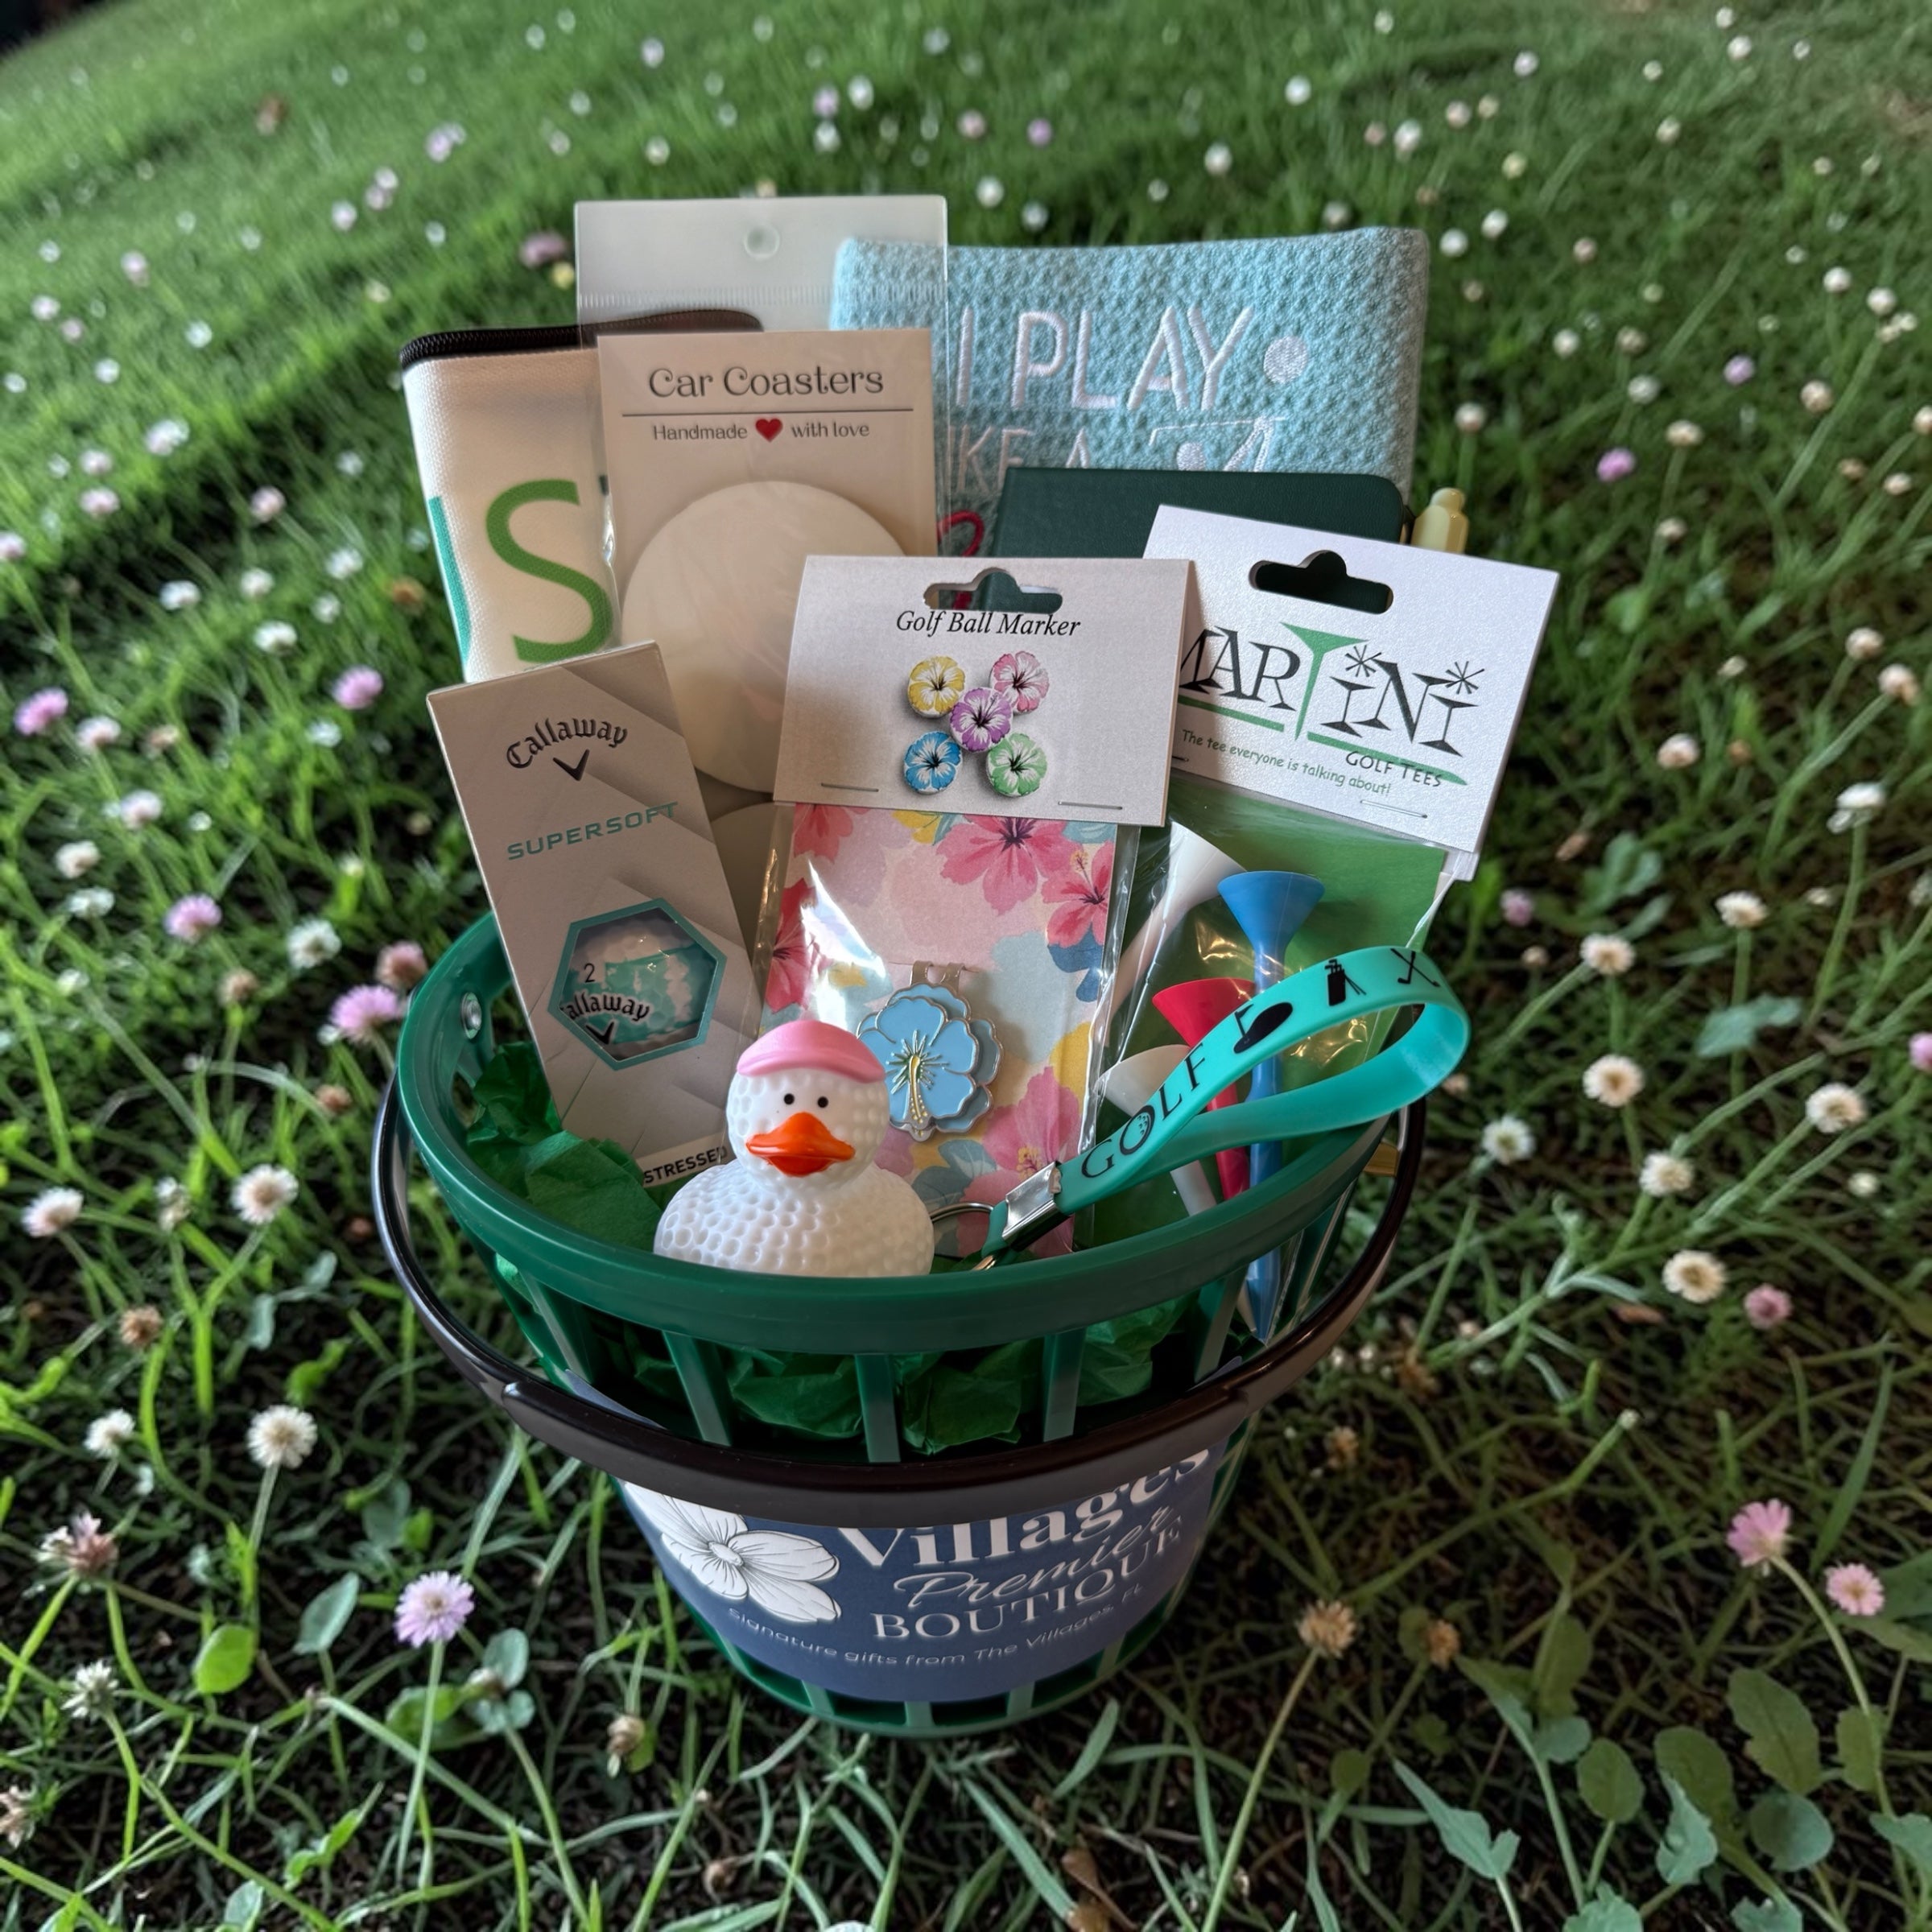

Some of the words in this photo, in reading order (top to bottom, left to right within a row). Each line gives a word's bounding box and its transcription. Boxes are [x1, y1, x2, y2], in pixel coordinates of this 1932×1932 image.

[956, 305, 974, 407] I
[1011, 305, 1256, 411] PLAY
[649, 367, 713, 398] Car
[723, 365, 885, 397] Coasters
[652, 423, 748, 442] Handmade
[791, 421, 828, 440] with
[832, 420, 870, 439] love
[943, 423, 1035, 493] IKE
[896, 609, 945, 638] Golf
[947, 610, 993, 635] Ball
[996, 612, 1082, 637] Marker
[506, 717, 628, 770] Callaway
[1182, 729, 1203, 746] The
[1207, 737, 1227, 753] tee
[1229, 745, 1284, 767] everyone
[1287, 758, 1298, 772] is
[1302, 762, 1346, 786] talking
[1348, 777, 1392, 796] about!
[1345, 751, 1396, 775] GOLF
[1400, 765, 1443, 788] TEES
[506, 800, 679, 861] SUPERSOFT
[584, 963, 596, 983] 2
[559, 991, 650, 1022] allaway
[1081, 1042, 1206, 1178] GOLF
[644, 1146, 728, 1184] STRESSED
[893, 1505, 1174, 1609] Premier
[844, 1650, 898, 1666] gifts
[906, 1651, 965, 1666] from
[974, 1645, 1018, 1660] The
